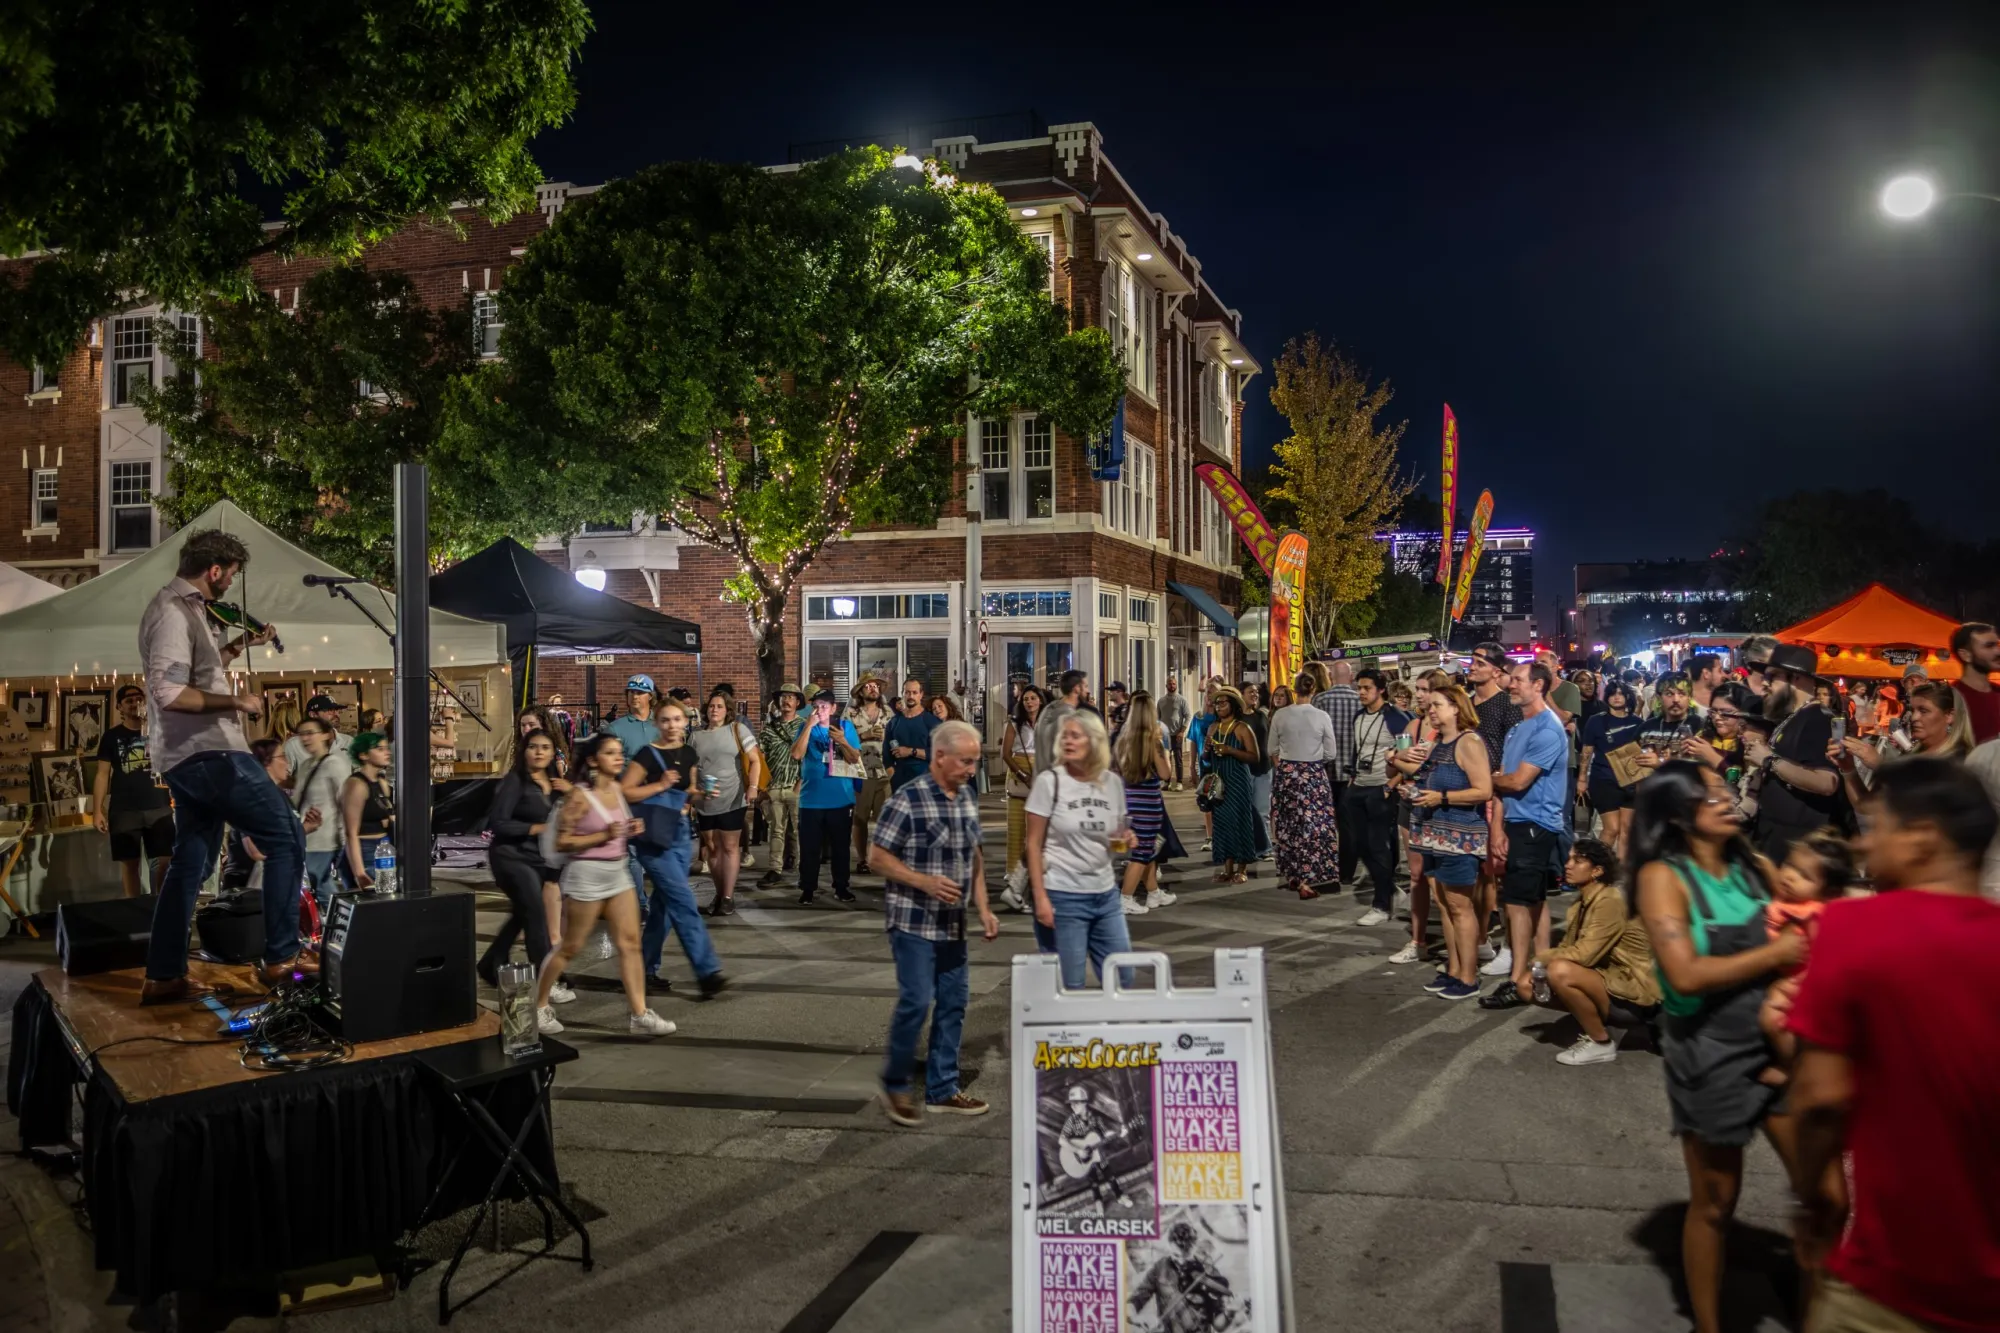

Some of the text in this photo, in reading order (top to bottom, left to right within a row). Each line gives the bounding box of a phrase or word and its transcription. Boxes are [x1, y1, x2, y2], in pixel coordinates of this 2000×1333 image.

[1163, 1063, 1234, 1074] MAGNOLIA
[1164, 1074, 1236, 1093] MAKE
[1164, 1093, 1237, 1106] BELIEVE
[1164, 1108, 1236, 1119] MAGNOLIA
[1165, 1119, 1238, 1138] MAKE
[1165, 1138, 1238, 1151] BELIEVE
[1166, 1154, 1238, 1166] MAGNOLIA
[1166, 1165, 1240, 1184] MAKE
[1166, 1184, 1241, 1199] BELIEVE
[1037, 1219, 1156, 1235] MEL GARSEK
[1043, 1244, 1113, 1256] MAGNOLIA
[1043, 1256, 1114, 1275] MAKE
[1043, 1275, 1115, 1289] BELIEVE
[1043, 1291, 1114, 1303] MAGNOLIA
[1044, 1303, 1115, 1323] MAKE
[1044, 1322, 1116, 1333] BELIEVE
